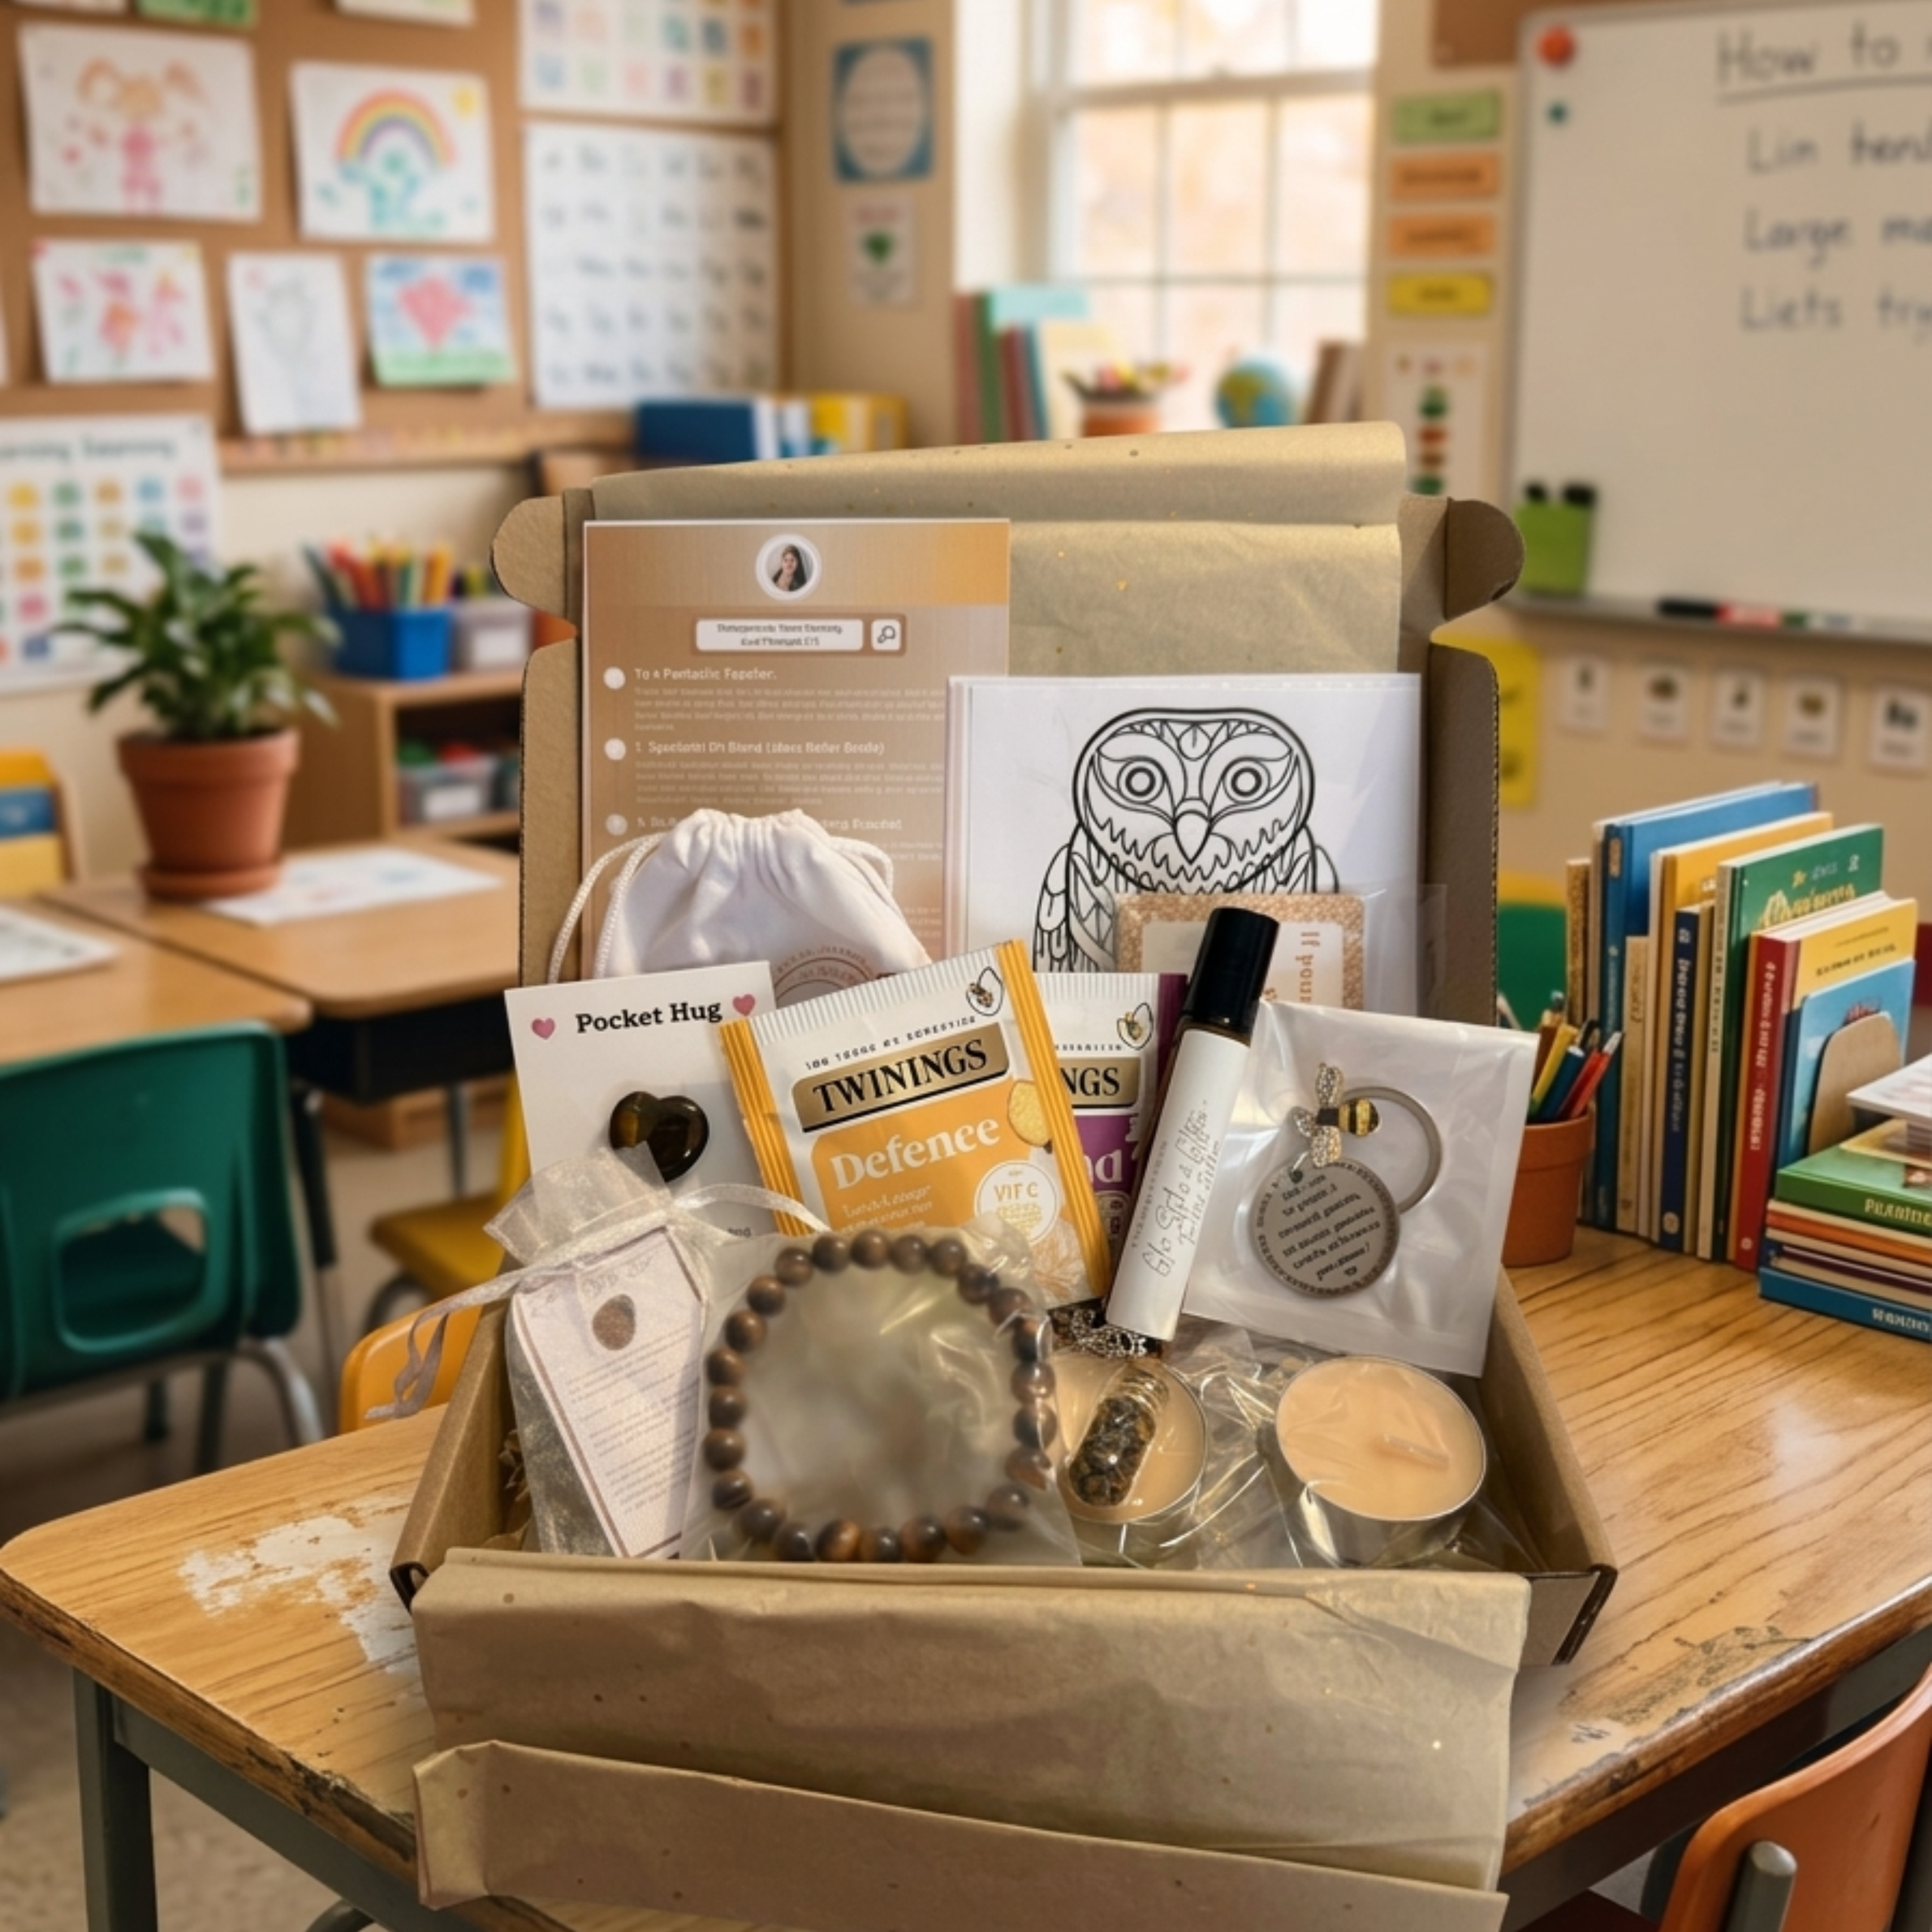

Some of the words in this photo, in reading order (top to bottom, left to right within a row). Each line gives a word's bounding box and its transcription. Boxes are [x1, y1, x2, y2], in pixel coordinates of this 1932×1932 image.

[1717, 29, 1819, 83] How
[1850, 20, 1901, 68] to
[575, 1007, 663, 1034] Pocket
[670, 1002, 723, 1024] Hug
[812, 1039, 987, 1113] TWININGS
[830, 1117, 1001, 1190] Defence
[993, 1182, 1024, 1203] VIT
[1026, 1182, 1039, 1199] C
